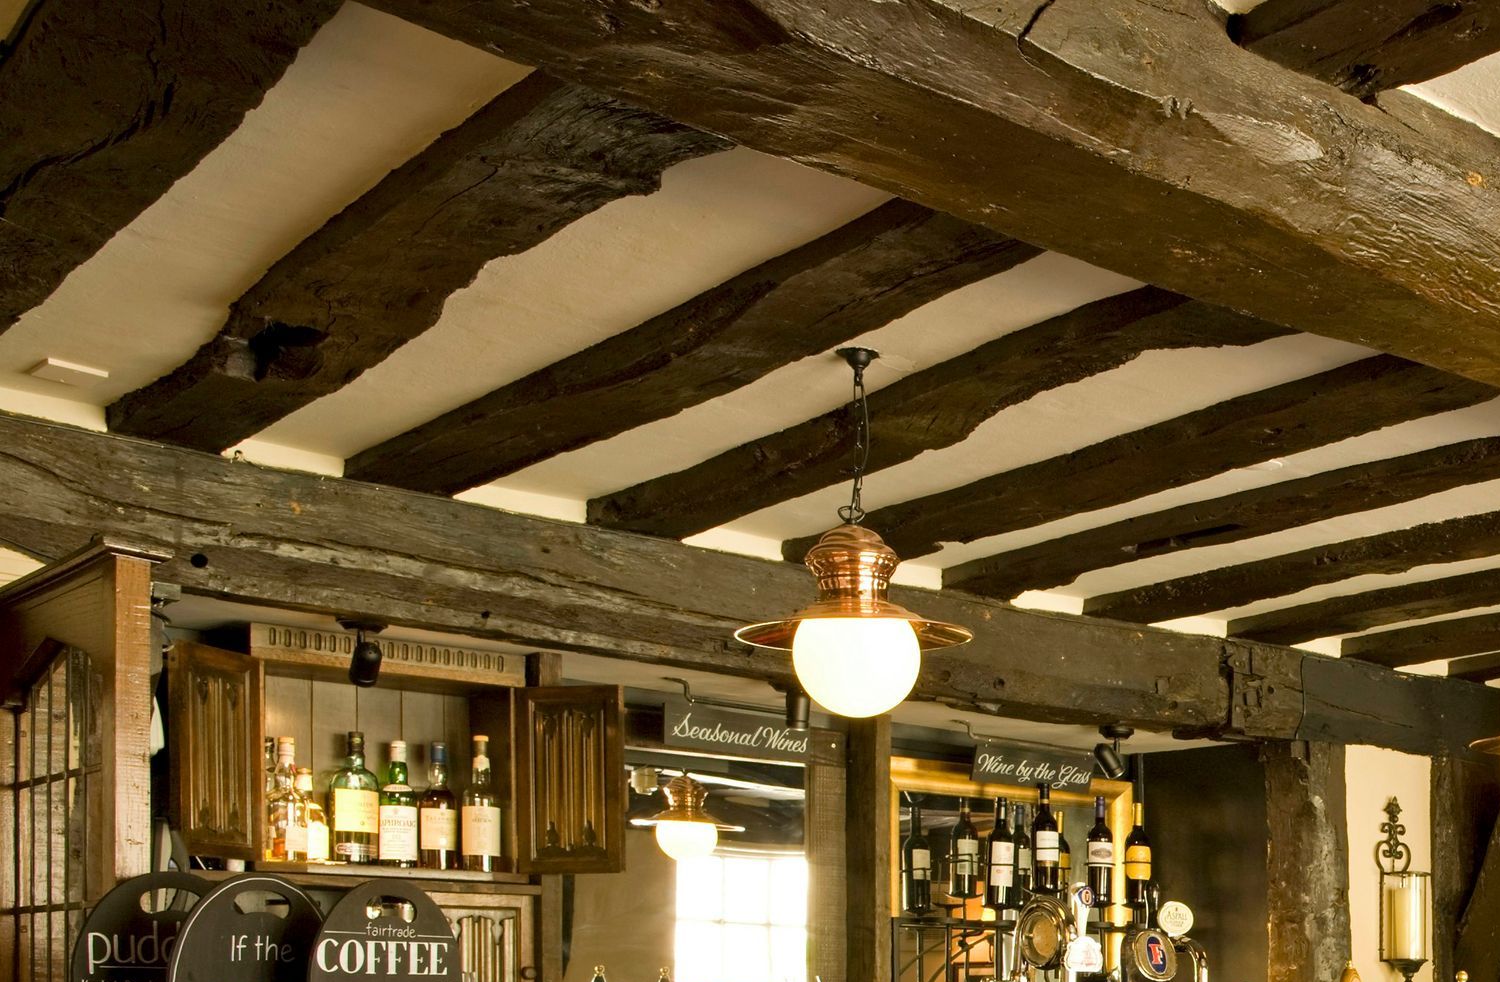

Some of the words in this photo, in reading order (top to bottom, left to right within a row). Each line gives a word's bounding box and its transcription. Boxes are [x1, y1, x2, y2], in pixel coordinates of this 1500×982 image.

[672, 712, 763, 747] Seasonal
[763, 727, 808, 753] Wines
[978, 754, 1014, 775] Wine
[1016, 760, 1034, 782] by
[1034, 762, 1056, 780] the
[1051, 764, 1092, 789] Glass
[366, 922, 417, 938] fairtrade
[231, 935, 248, 961] If
[254, 935, 295, 963] the
[316, 938, 448, 976] COFFEE
